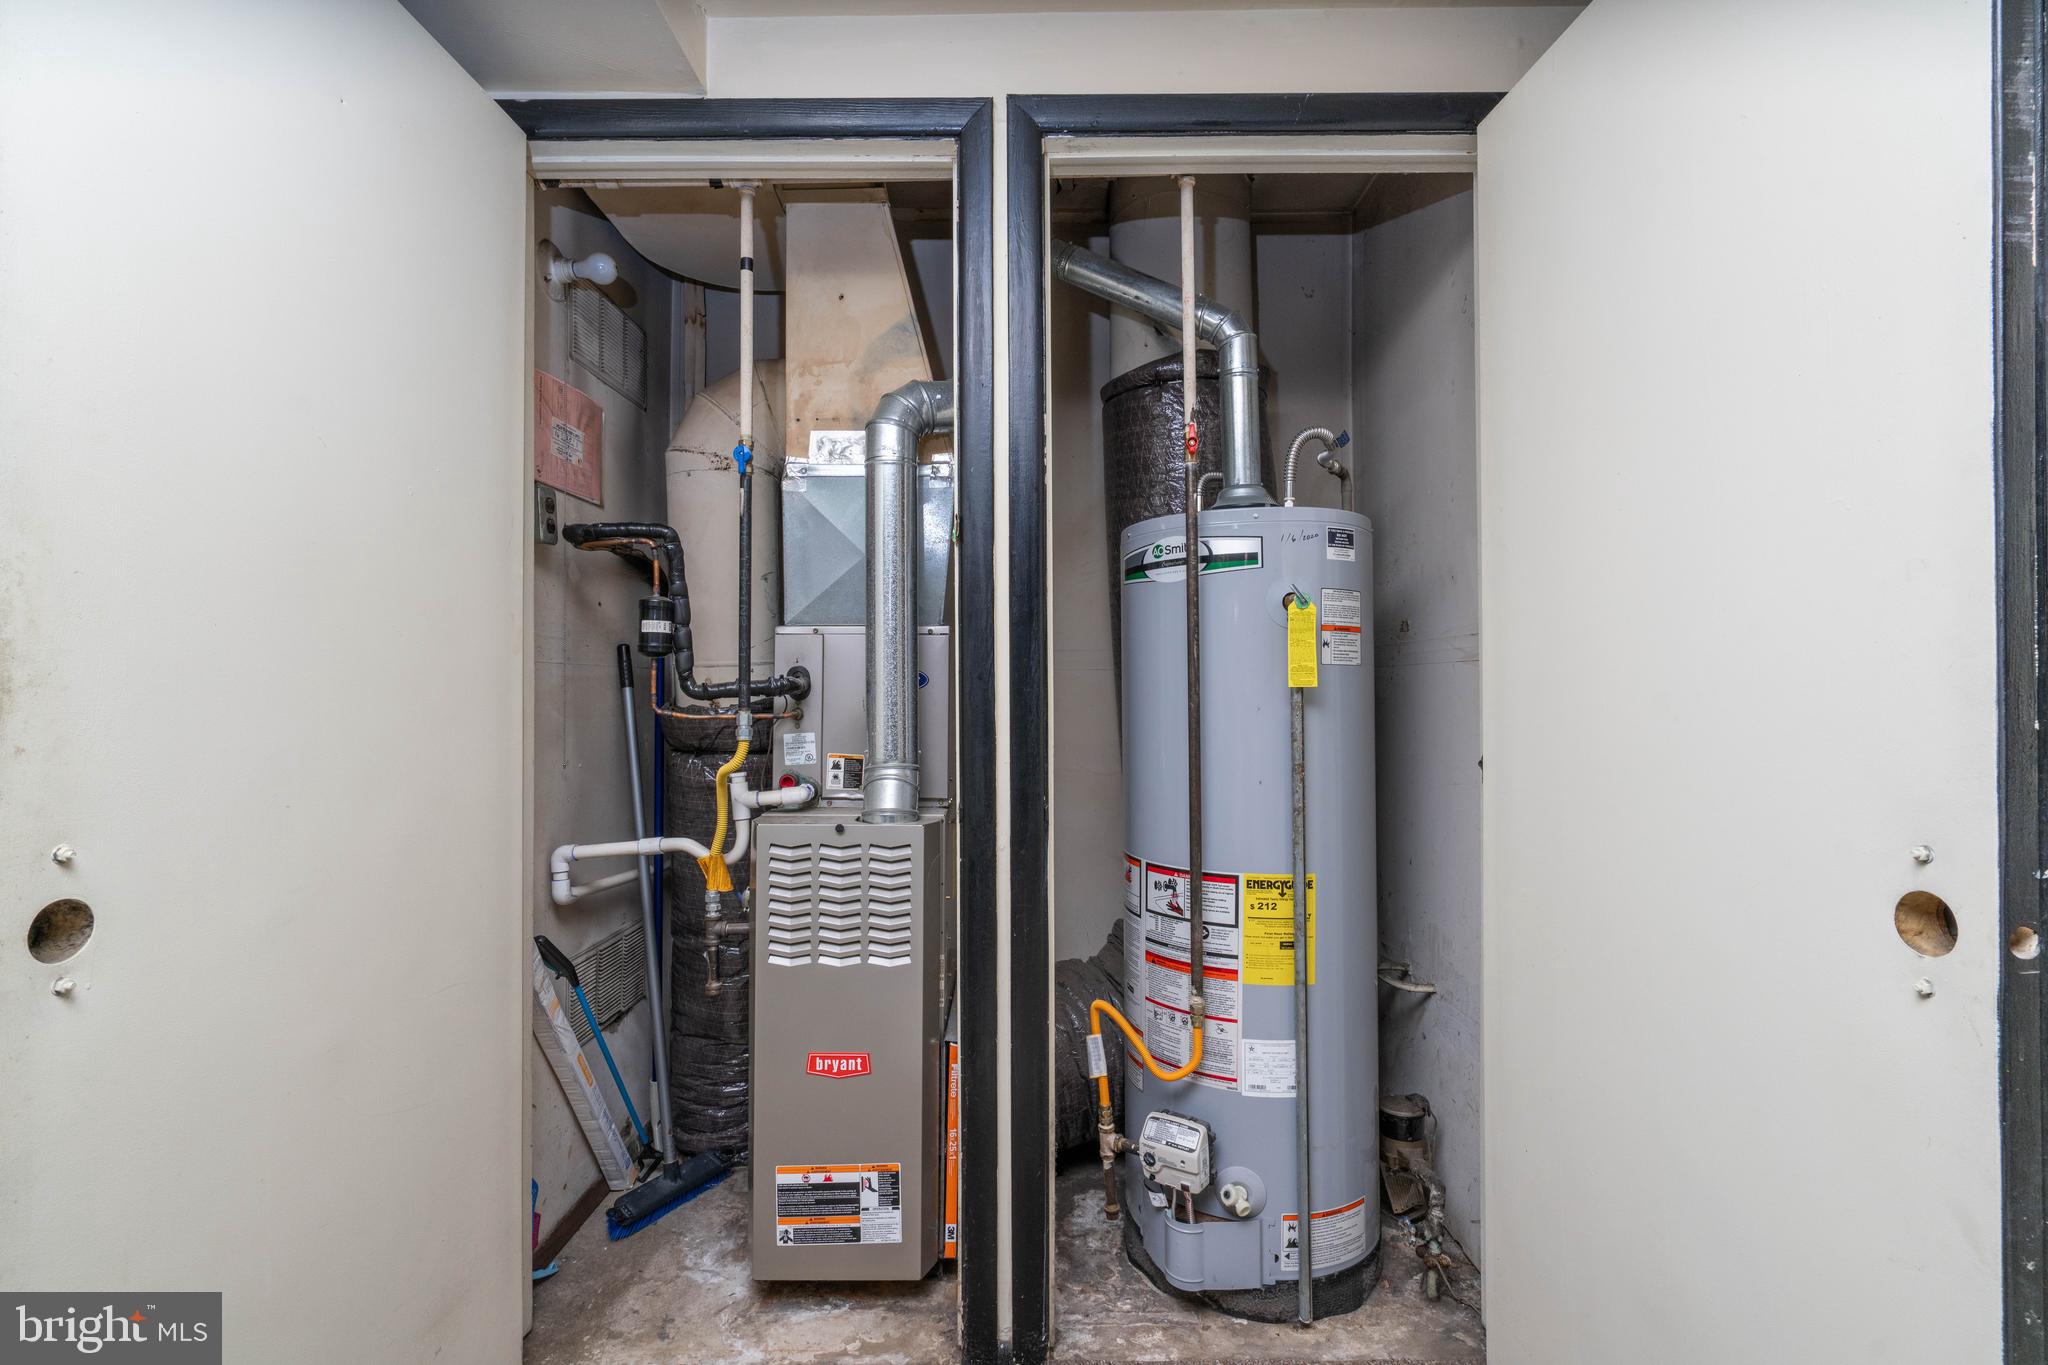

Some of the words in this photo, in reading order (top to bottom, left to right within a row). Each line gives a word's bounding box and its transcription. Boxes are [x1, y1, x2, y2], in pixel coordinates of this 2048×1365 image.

[1257, 902, 1277, 911] 212
[816, 1056, 862, 1073] bryant
[950, 1063, 961, 1098] Filtrete
[947, 1225, 956, 1240] 3M
